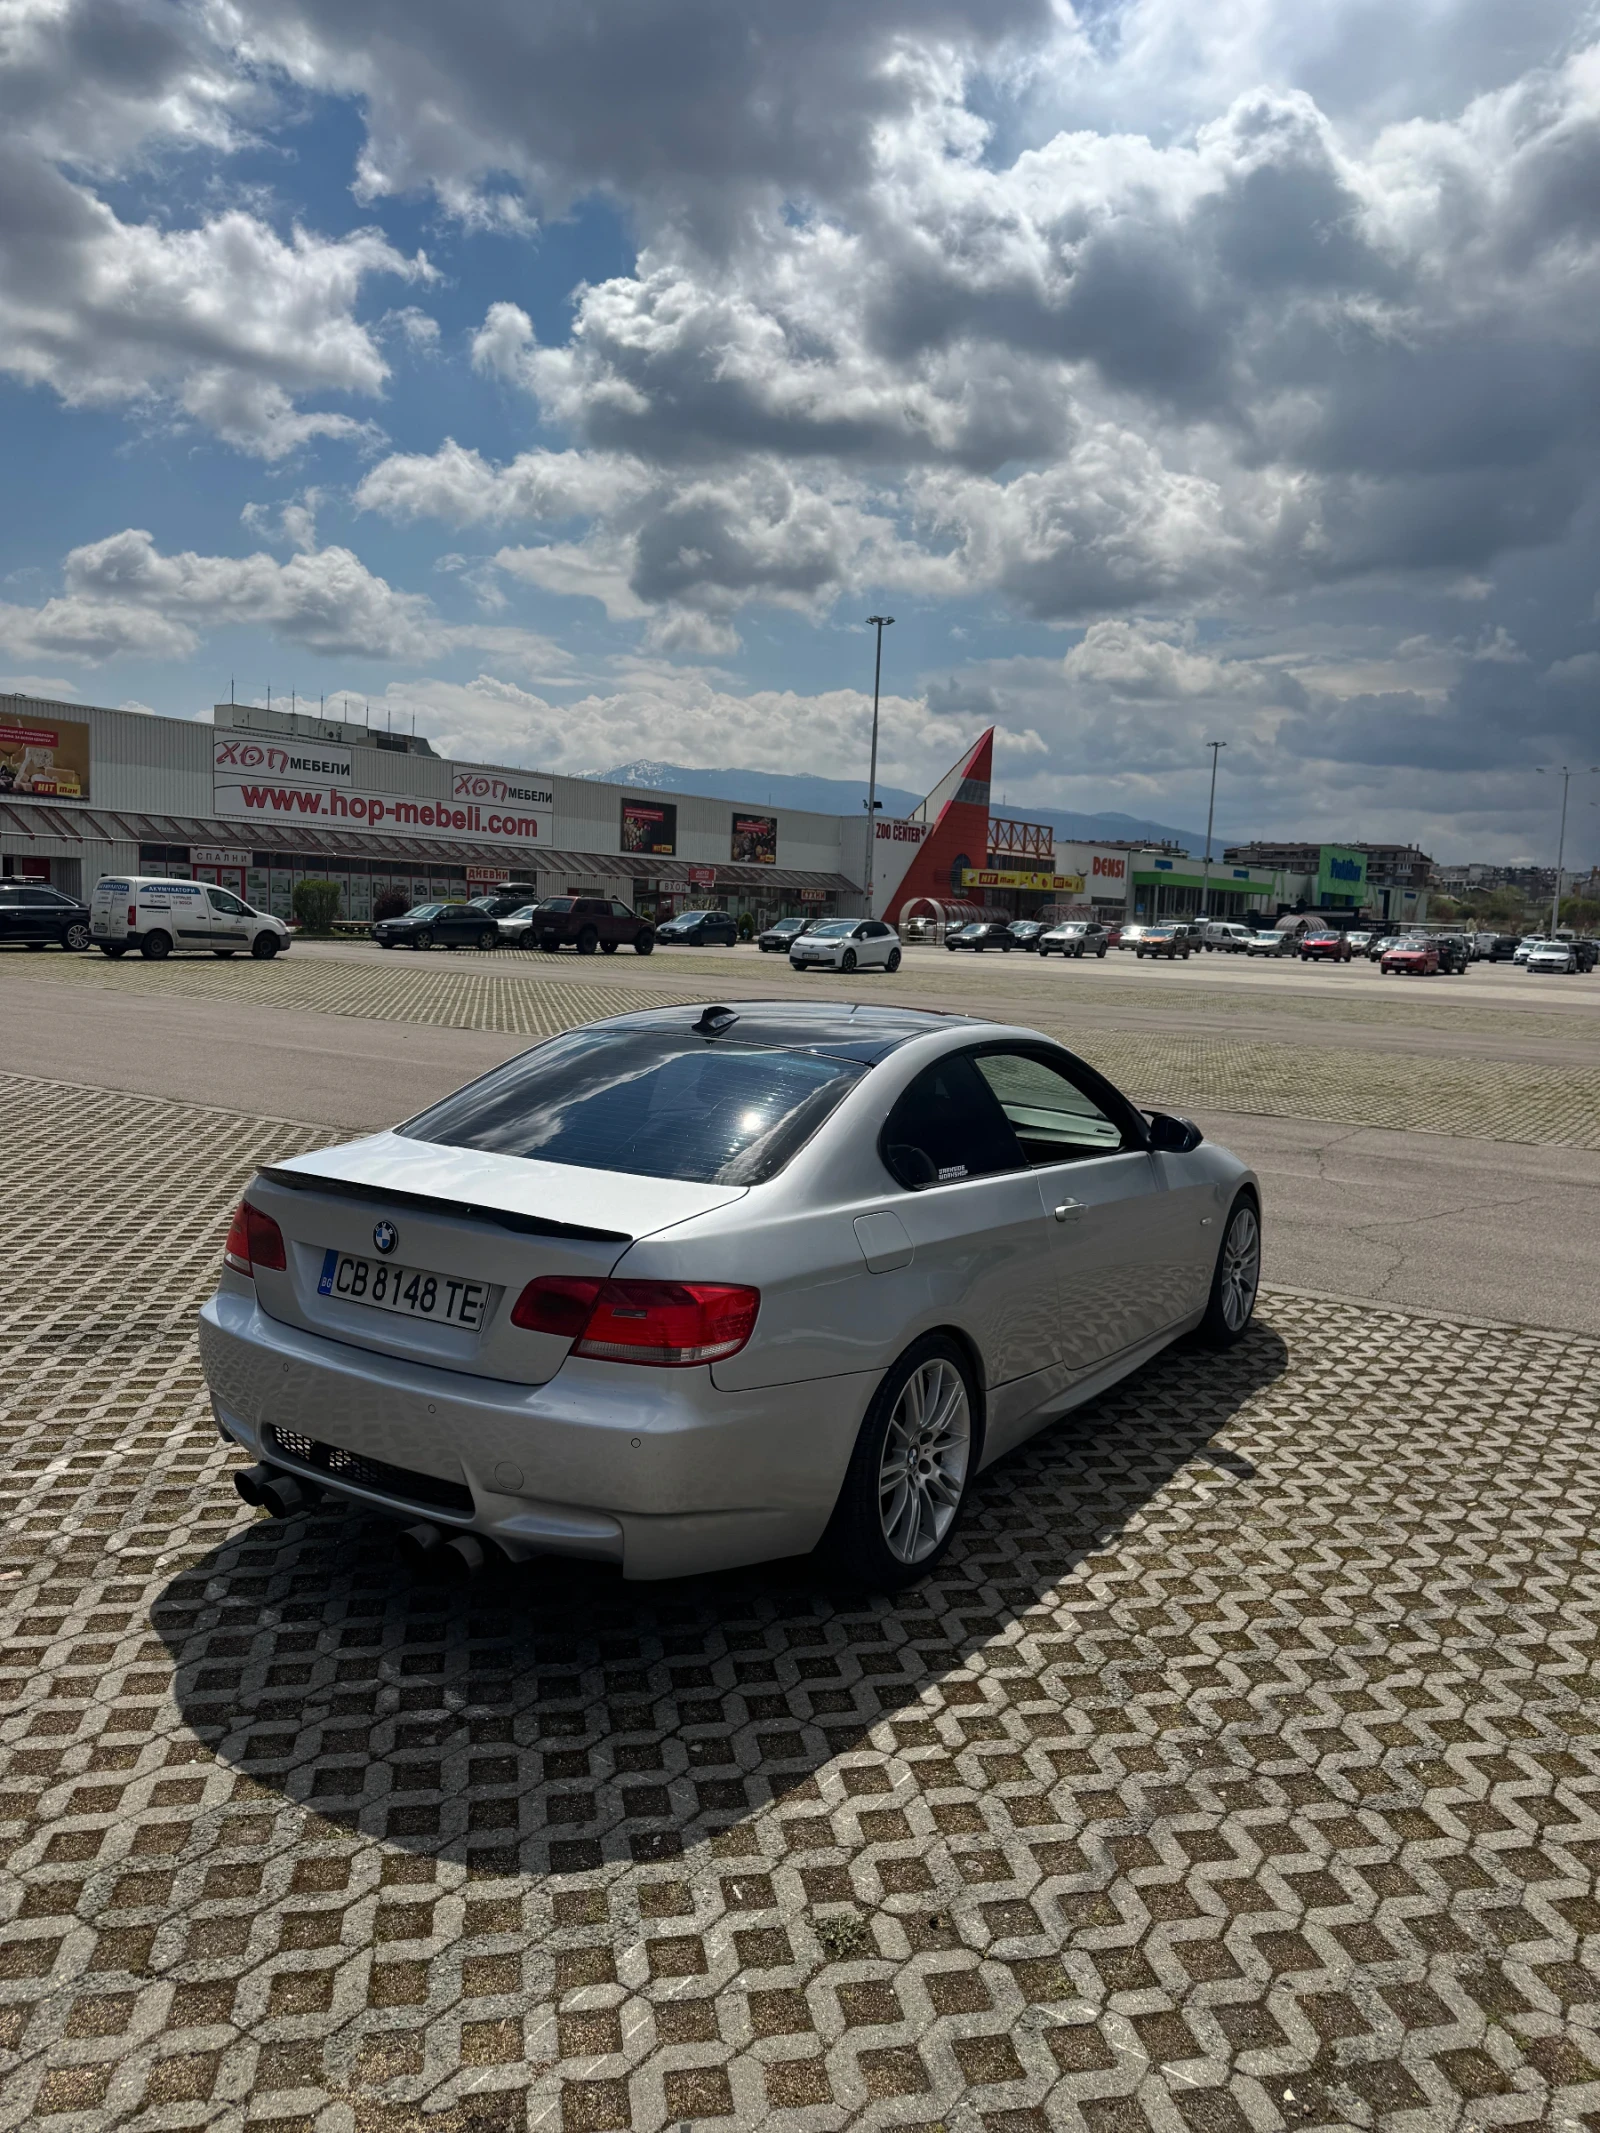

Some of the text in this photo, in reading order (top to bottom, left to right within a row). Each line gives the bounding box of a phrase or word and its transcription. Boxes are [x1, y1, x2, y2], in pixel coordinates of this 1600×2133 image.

[216, 741, 350, 776] ХОП МЕБЕЛИ
[37, 783, 55, 792] HIT
[454, 774, 553, 803] ХОП МЕБЕЛИ
[240, 785, 538, 838] www.hop-mebeli.com
[876, 822, 921, 843] ZOO CENTER
[196, 852, 248, 863] СПАЛНИ
[1092, 856, 1125, 878] DENSI
[468, 867, 509, 880] ДНЕВНИ
[980, 874, 997, 884] HIT
[149, 885, 195, 894] АКУМУЛАТОРИ
[664, 883, 687, 892] ВХОД
[1054, 879, 1064, 888] HIT
[802, 890, 825, 900] КУХНИ
[321, 1276, 332, 1288] BG
[336, 1258, 482, 1324] CB 8148 TE
